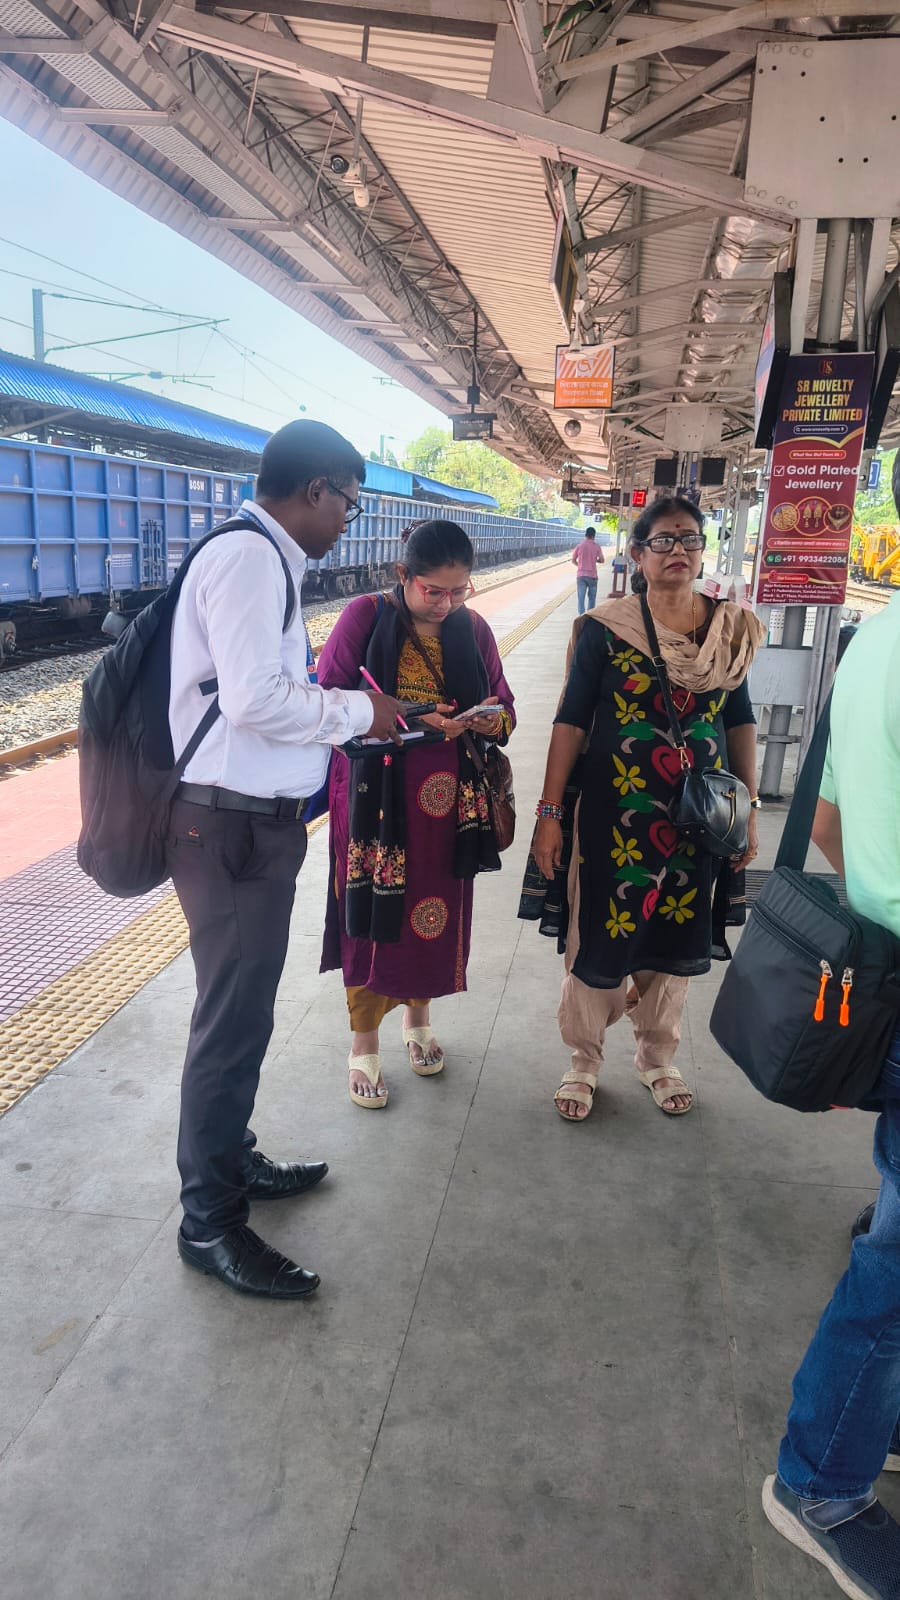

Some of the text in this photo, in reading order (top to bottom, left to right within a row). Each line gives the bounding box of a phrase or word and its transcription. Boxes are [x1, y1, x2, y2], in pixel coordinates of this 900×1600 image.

[797, 379, 854, 393] SR NOVELTY
[794, 394, 850, 407] JEWELLERY
[782, 408, 863, 422] PRIVATE LIMITED
[786, 465, 816, 475] Gold
[820, 465, 859, 475] Plated
[785, 479, 843, 491] Jewellery
[783, 554, 796, 563] +91
